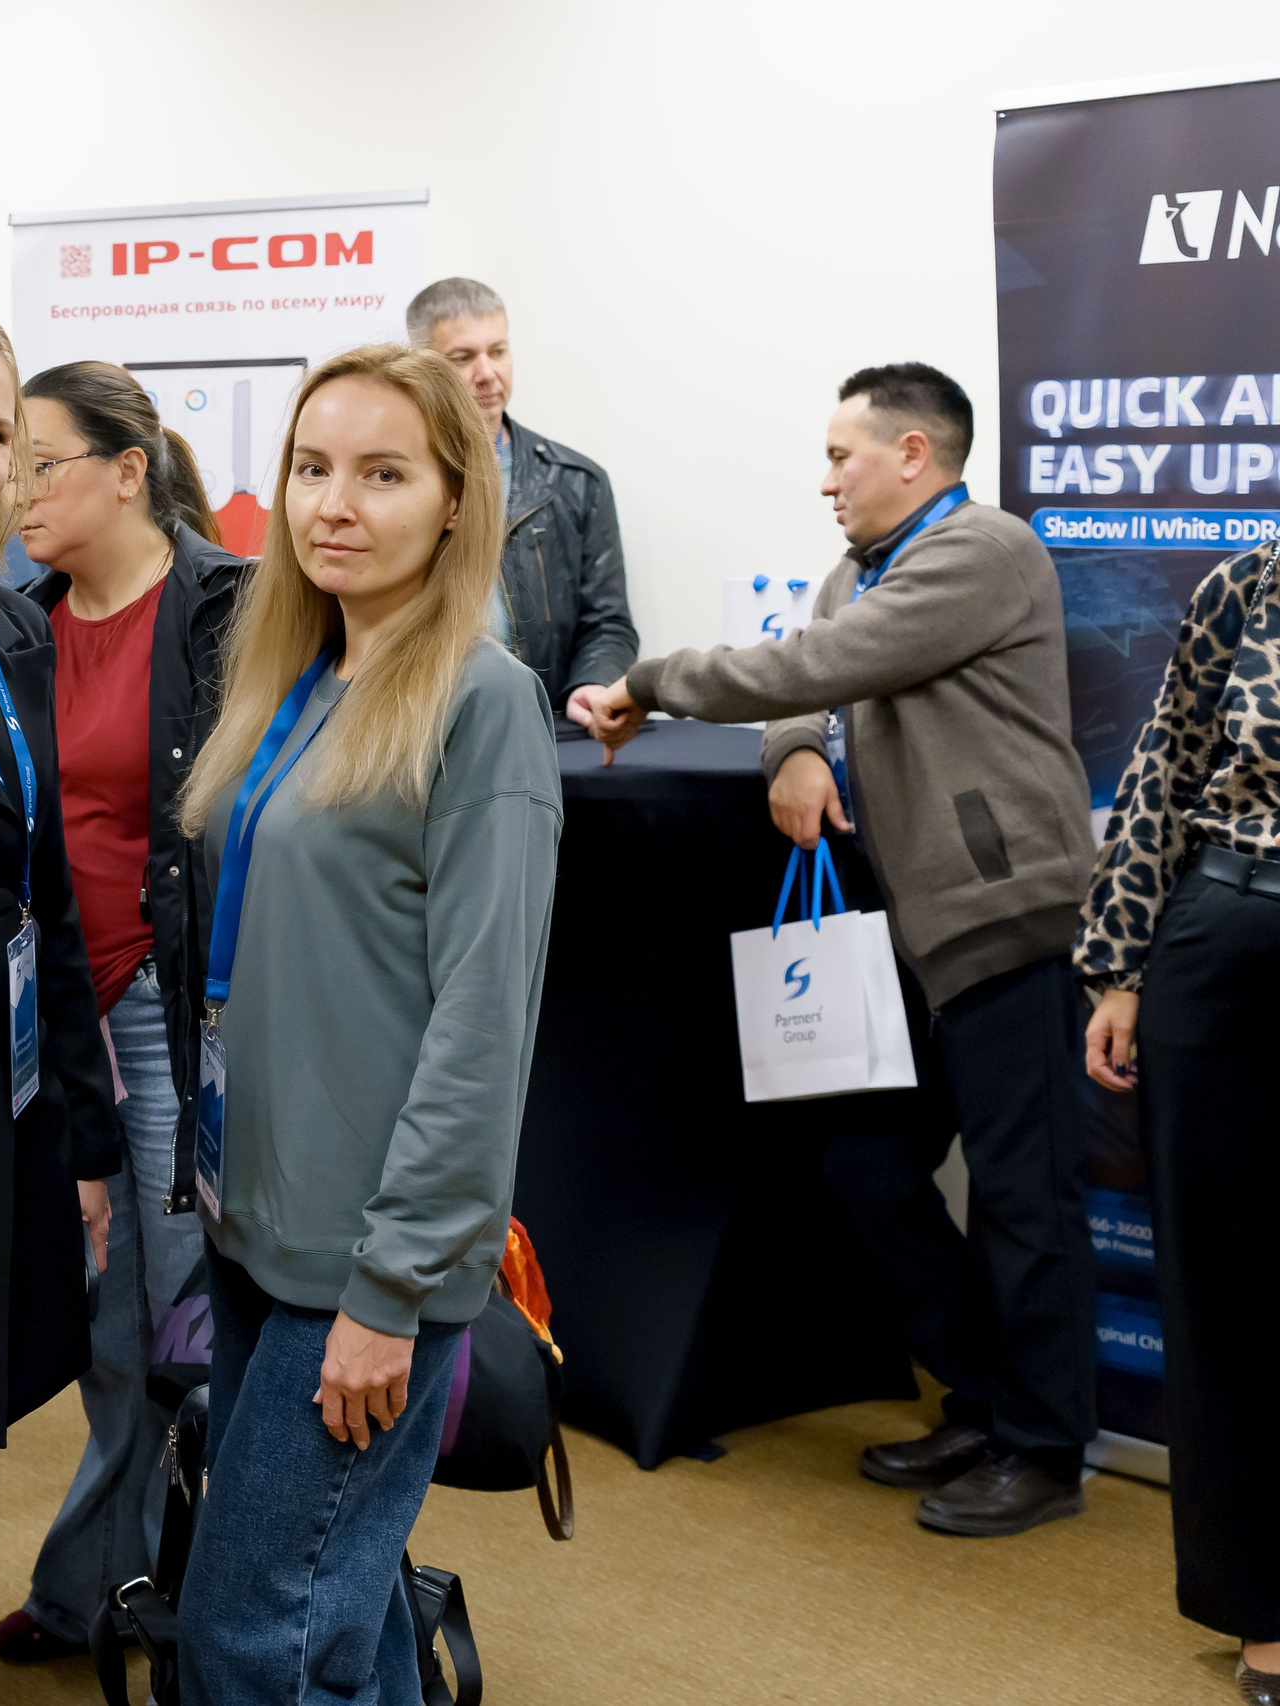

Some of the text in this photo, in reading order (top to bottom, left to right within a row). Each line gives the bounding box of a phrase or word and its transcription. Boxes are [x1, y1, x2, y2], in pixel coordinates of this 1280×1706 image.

[1227, 185, 1280, 260] N
[111, 230, 374, 276] IP-COM
[50, 294, 386, 321] Беспроводная связь по всему миру
[1030, 373, 1280, 439] QUICK A
[1029, 443, 1280, 495] EASY UP
[1044, 515, 1128, 540] Shadow
[1151, 516, 1221, 541] White
[783, 1030, 816, 1044] Group
